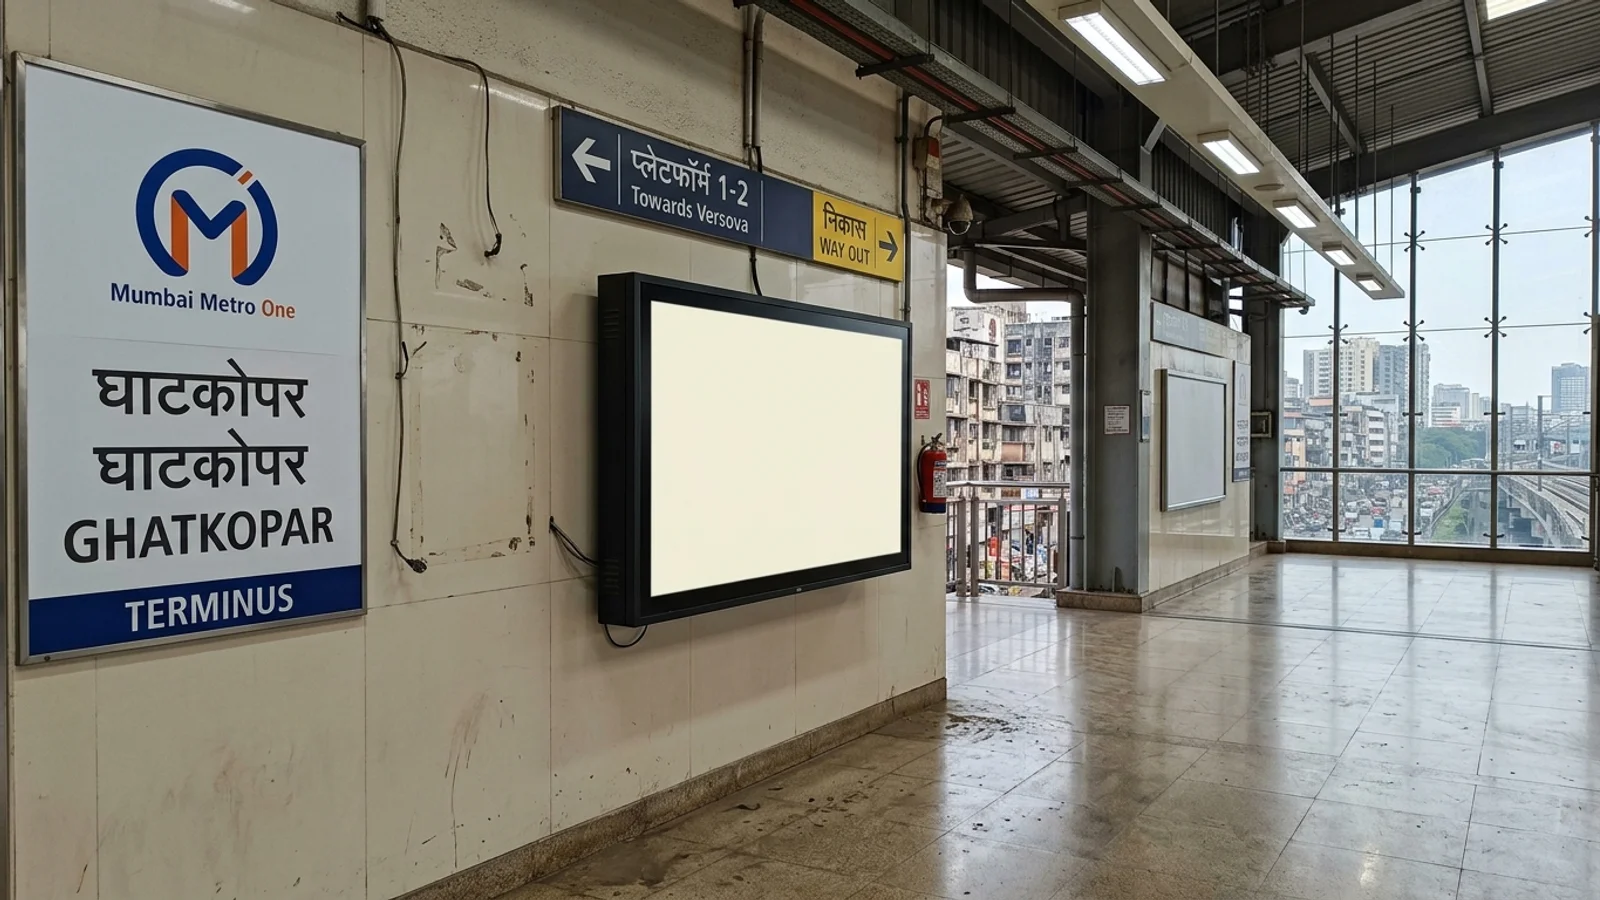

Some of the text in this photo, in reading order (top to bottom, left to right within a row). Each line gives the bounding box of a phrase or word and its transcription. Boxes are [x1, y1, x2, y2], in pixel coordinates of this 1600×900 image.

[630, 144, 749, 208] प्लेटफॉर्म 1-2
[631, 185, 749, 234] Towards Versova
[822, 201, 867, 241] निकास
[819, 236, 870, 265] WAY OUT
[110, 282, 296, 319] Mumbai Metro One
[92, 357, 309, 419] घाटकोपर
[92, 427, 309, 492] घाटकोपर
[63, 506, 334, 564] GHATKOPAR
[125, 583, 294, 632] TERMINUS
